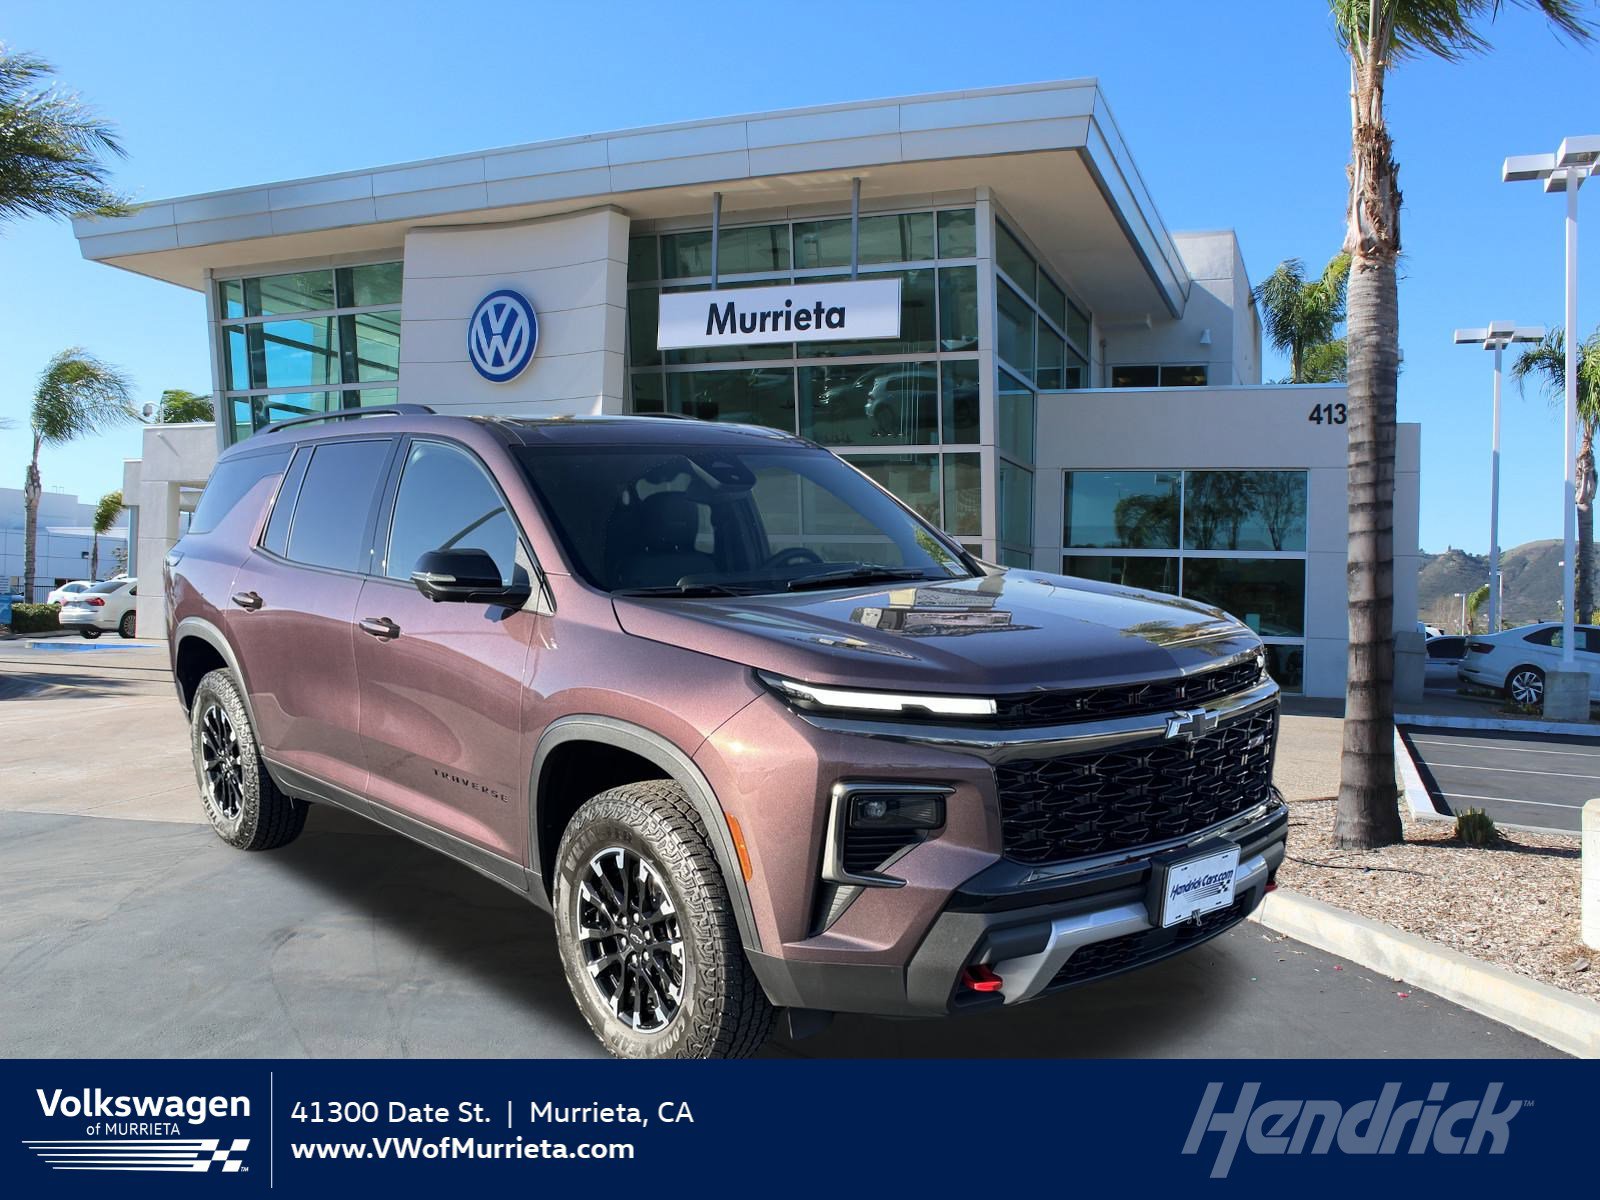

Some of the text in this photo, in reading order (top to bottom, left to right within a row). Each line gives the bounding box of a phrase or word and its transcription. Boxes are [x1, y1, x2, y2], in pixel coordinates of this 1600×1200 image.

[706, 299, 846, 336] Murrieta
[470, 297, 532, 375] VW
[1308, 403, 1347, 425] 413
[432, 768, 509, 803] TRAVERSE
